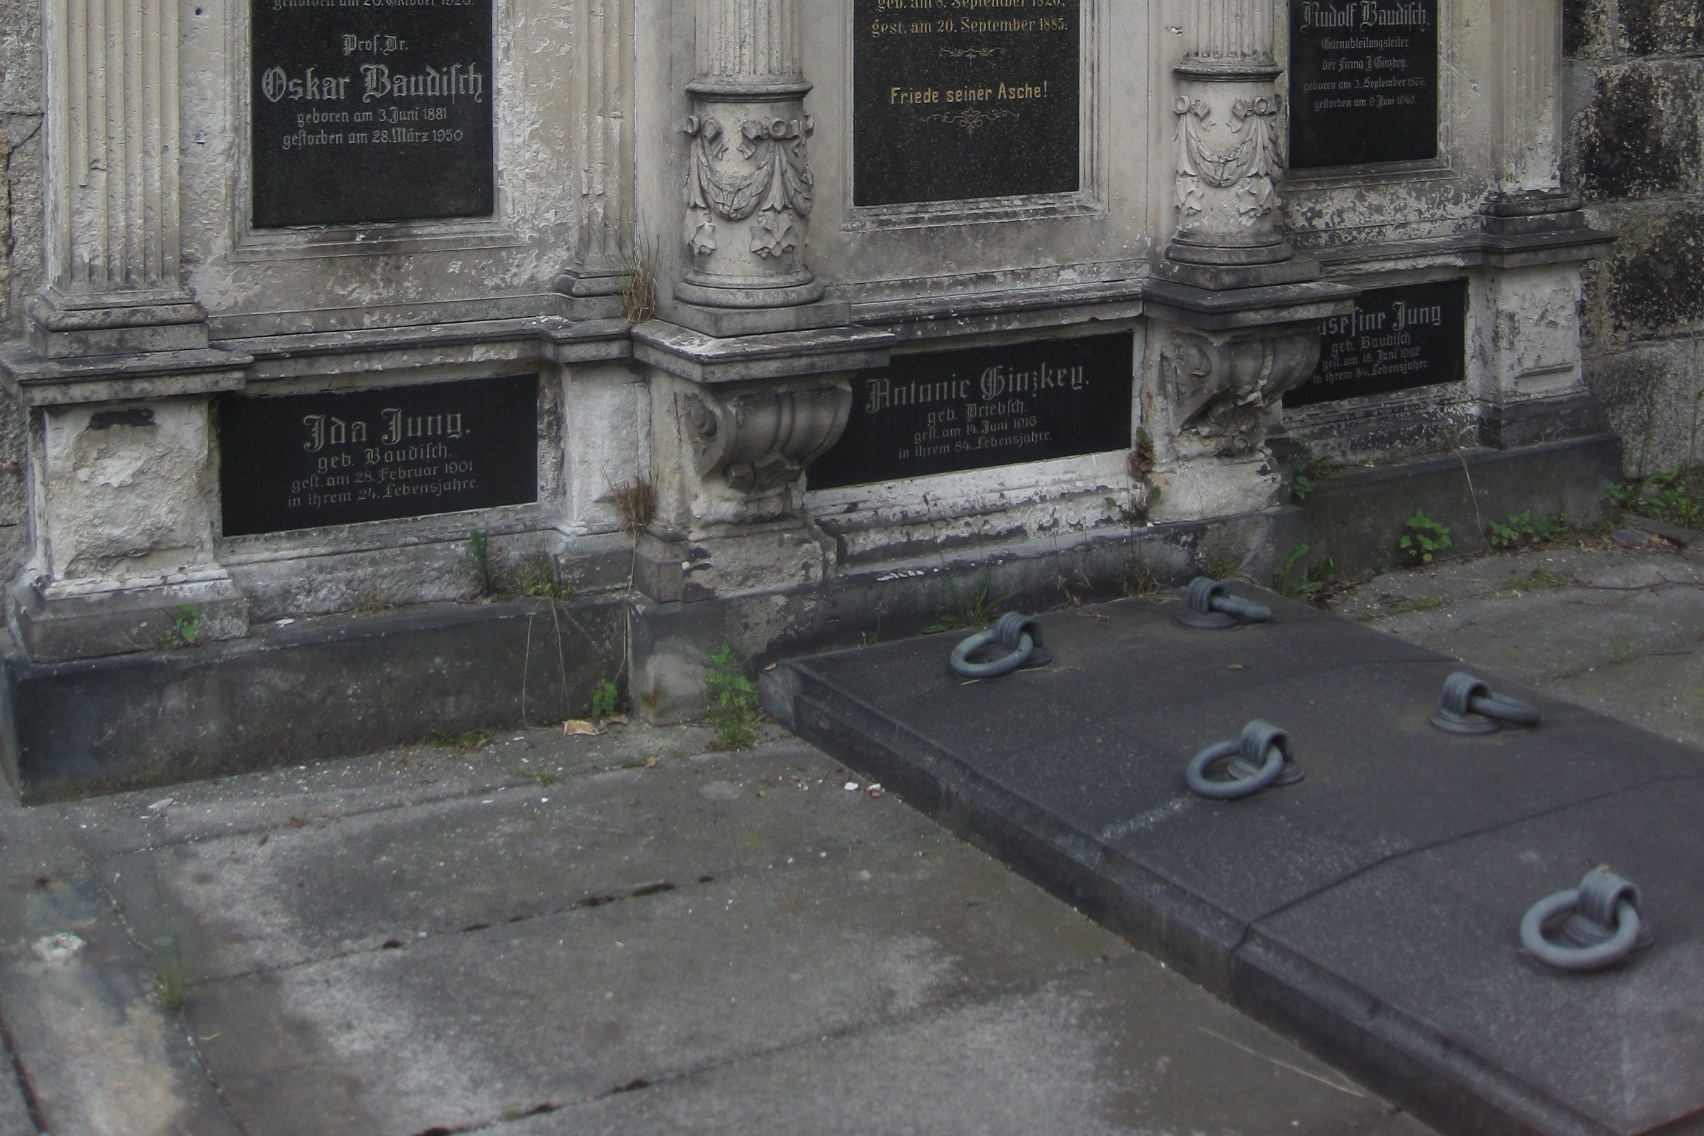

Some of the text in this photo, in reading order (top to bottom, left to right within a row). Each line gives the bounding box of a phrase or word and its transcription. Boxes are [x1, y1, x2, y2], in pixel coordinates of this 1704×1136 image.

[871, 19, 907, 38] gest.
[911, 22, 932, 33] am
[937, 19, 957, 33] 20.
[960, 17, 1036, 34] September
[384, 35, 409, 55] Dr.
[1323, 59, 1336, 71] der
[262, 66, 351, 103] Oskar
[890, 80, 1048, 105] Friede seiner Asche!
[1338, 81, 1351, 89] am
[1354, 99, 1366, 107] am
[297, 106, 448, 127] geboren am 3. Juni 1881
[349, 132, 368, 144] am
[372, 131, 392, 144] 28.
[392, 128, 429, 144] März
[432, 129, 464, 142] 1950
[1392, 301, 1441, 332] Jung
[1377, 350, 1398, 363] Juni
[1325, 372, 1352, 384] ihrem
[865, 374, 971, 413] Antonie
[927, 408, 958, 427] geb.
[942, 428, 961, 438] am
[981, 417, 1008, 435] Juni
[898, 447, 909, 459] in
[915, 442, 950, 458] ihrem
[317, 453, 355, 474] geb.
[326, 475, 349, 486] am
[354, 471, 376, 484] 28.
[377, 464, 439, 483] Februar
[445, 460, 473, 474] 1901
[288, 495, 301, 508] in
[308, 492, 351, 508] ihrem
